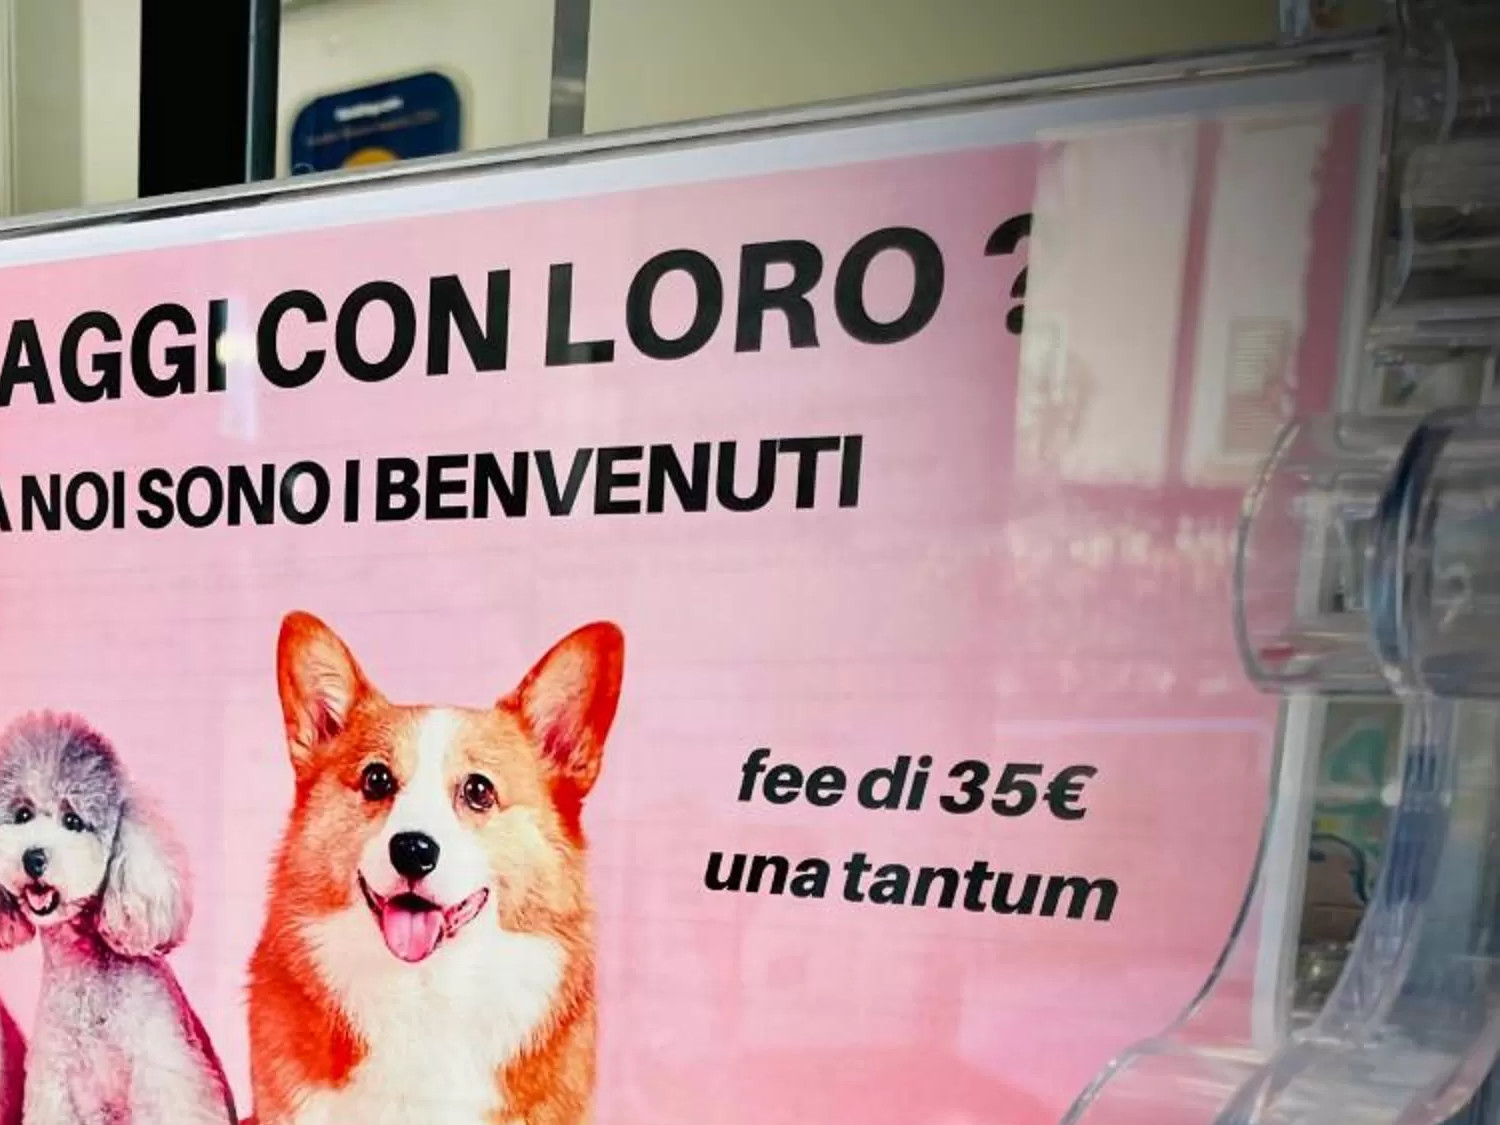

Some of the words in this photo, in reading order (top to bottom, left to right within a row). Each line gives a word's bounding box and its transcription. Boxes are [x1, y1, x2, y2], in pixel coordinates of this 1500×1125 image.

[256, 269, 511, 389] CON
[545, 226, 945, 367] LORO
[21, 471, 125, 531] NOI
[136, 460, 331, 529] SONO
[343, 459, 361, 523] I
[375, 434, 863, 522] BENVENUTI
[738, 748, 847, 807] fee
[857, 755, 933, 811] di
[939, 759, 1098, 821] 35€
[704, 852, 830, 898] una
[843, 853, 1119, 922] tantum
